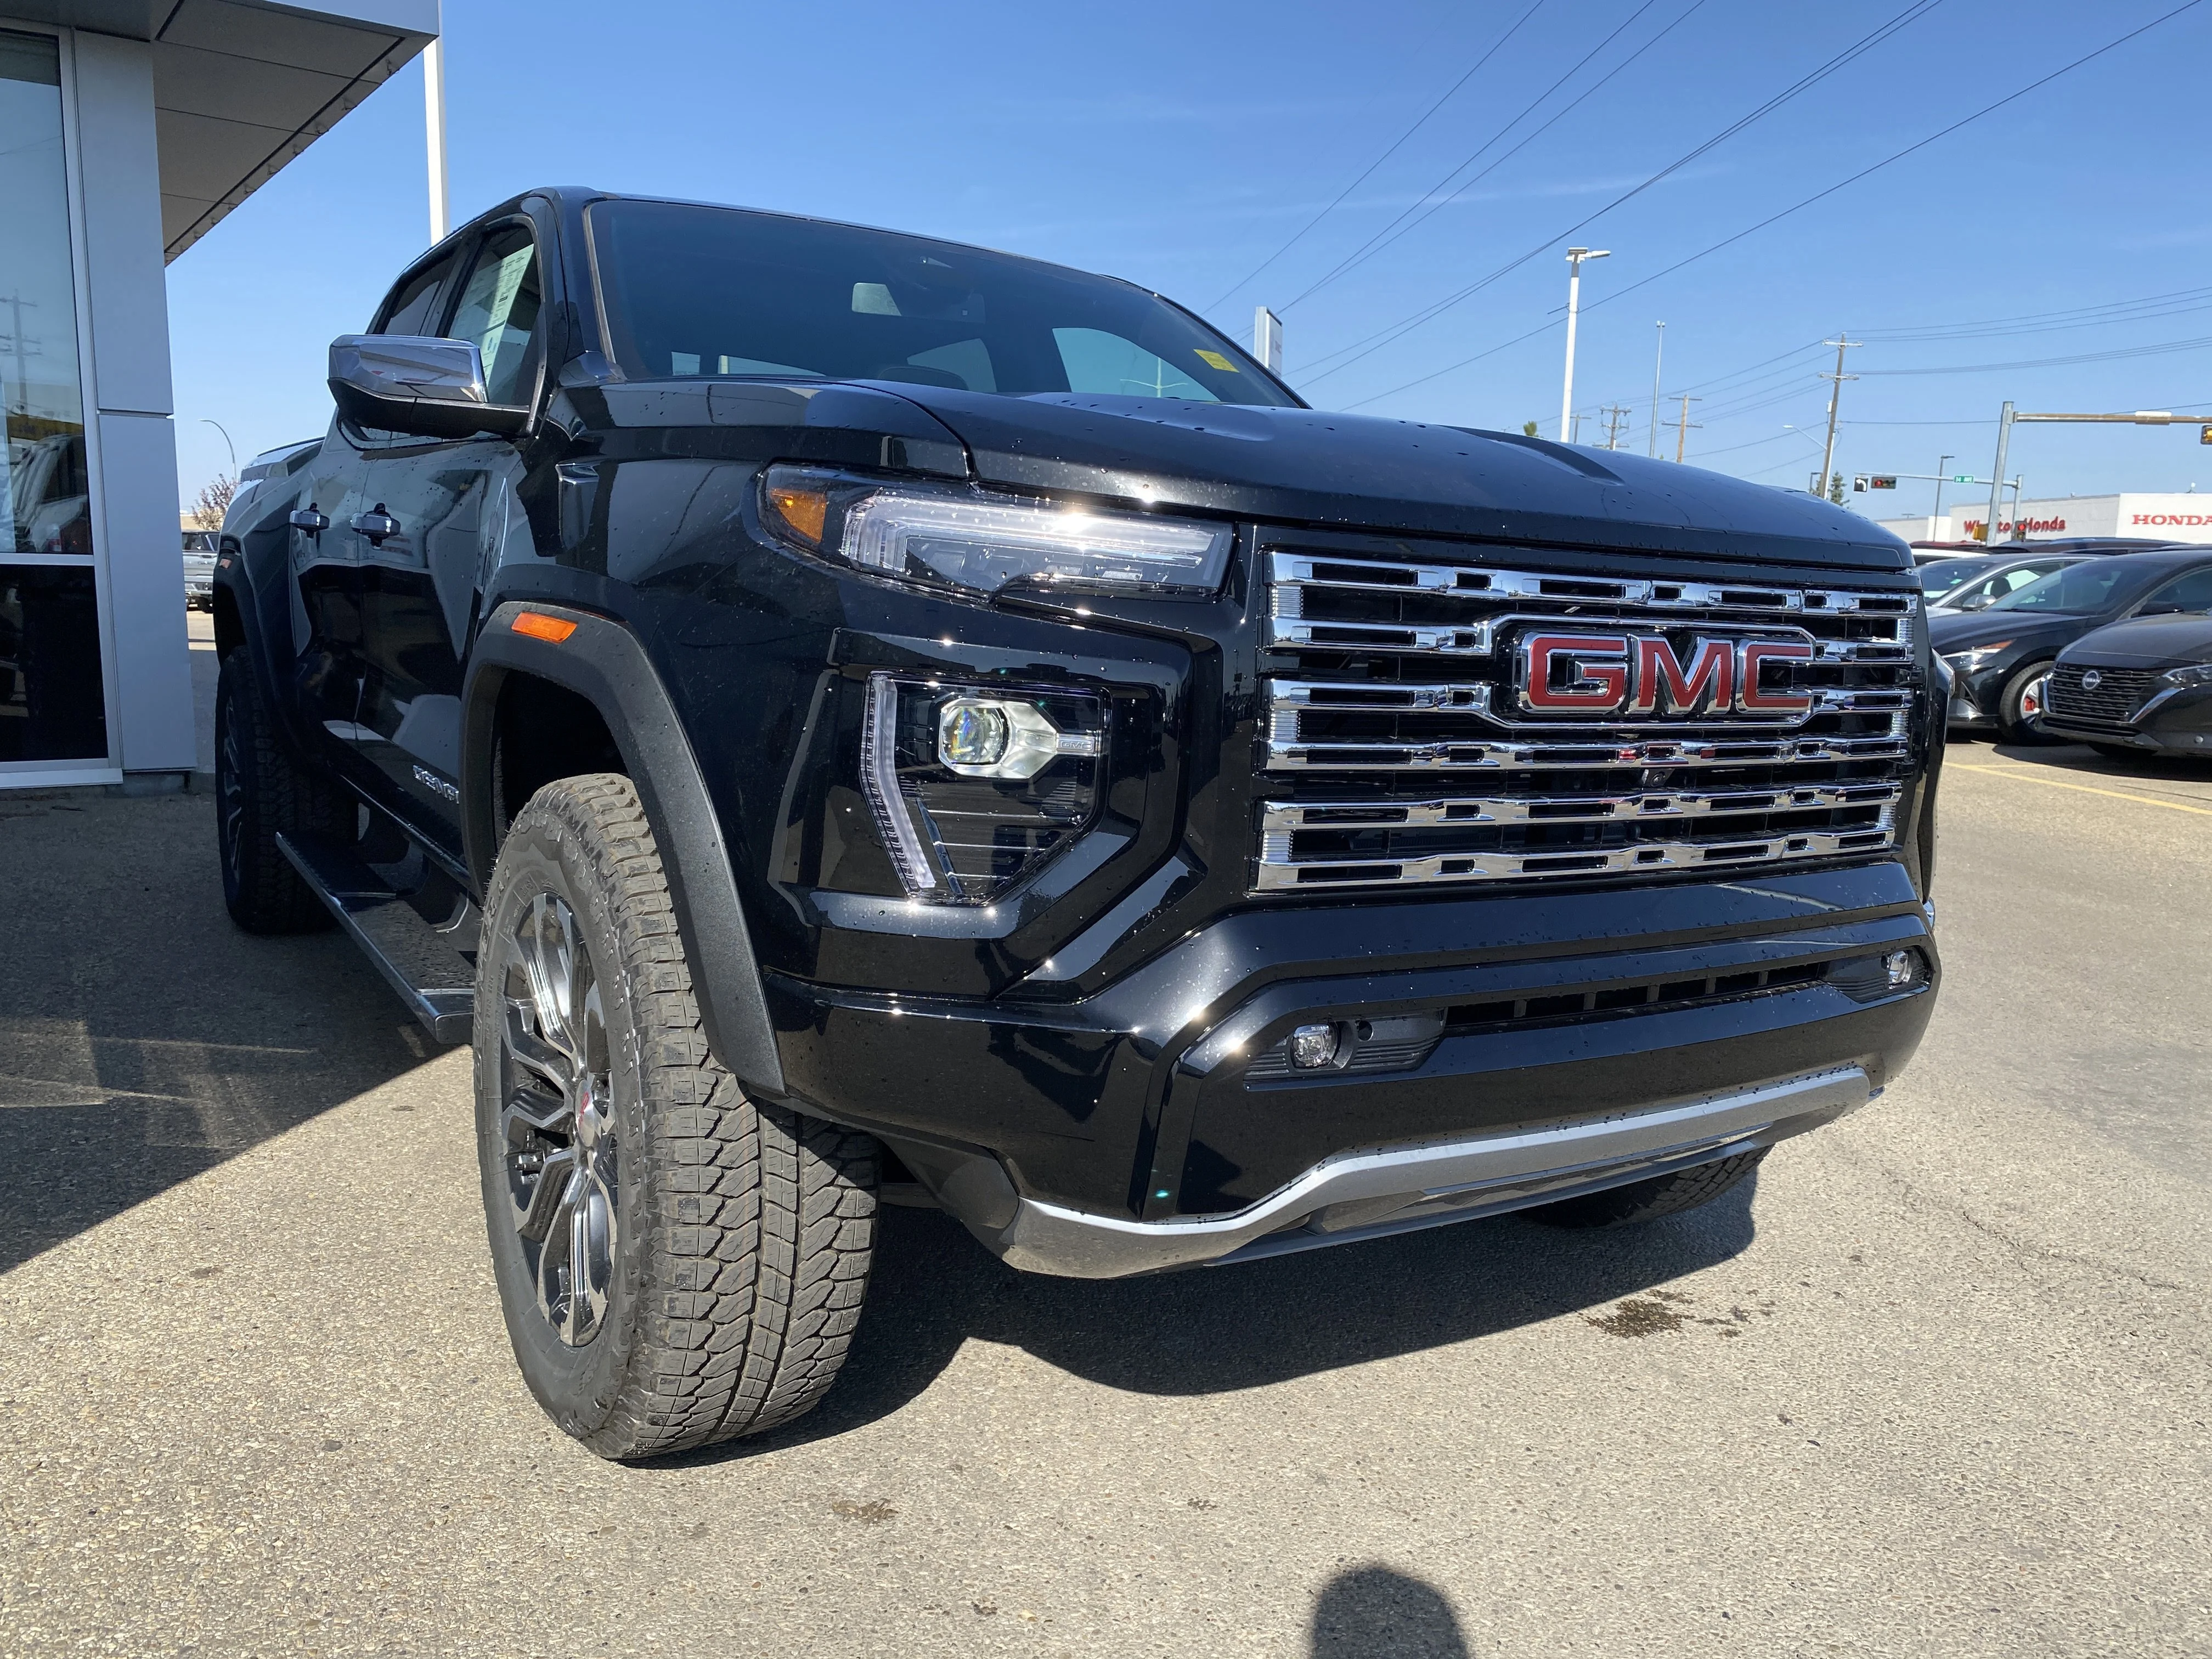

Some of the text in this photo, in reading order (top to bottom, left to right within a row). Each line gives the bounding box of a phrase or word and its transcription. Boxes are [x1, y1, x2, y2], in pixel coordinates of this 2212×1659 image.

[2024, 516, 2066, 533] Honda
[1519, 632, 1813, 714] GMC
[1060, 741, 1093, 751] GMC
